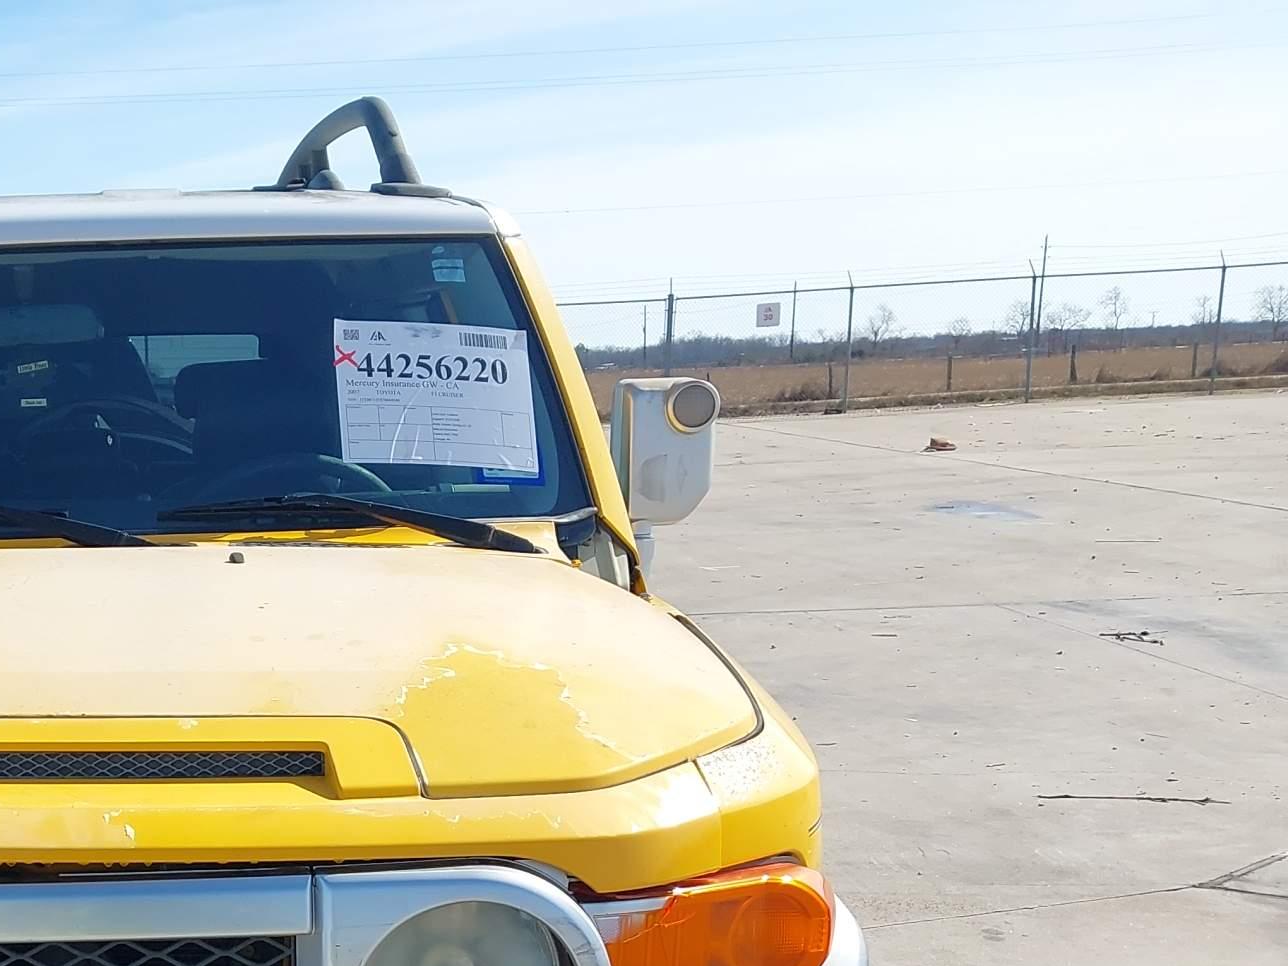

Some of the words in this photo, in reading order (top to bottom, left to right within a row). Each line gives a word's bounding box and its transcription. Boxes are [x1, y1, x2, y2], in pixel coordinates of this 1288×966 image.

[357, 352, 508, 385] 44256220
[345, 379, 380, 389] Mercury
[382, 380, 421, 389] Insurance
[421, 380, 438, 389] GW
[445, 381, 460, 390] CA
